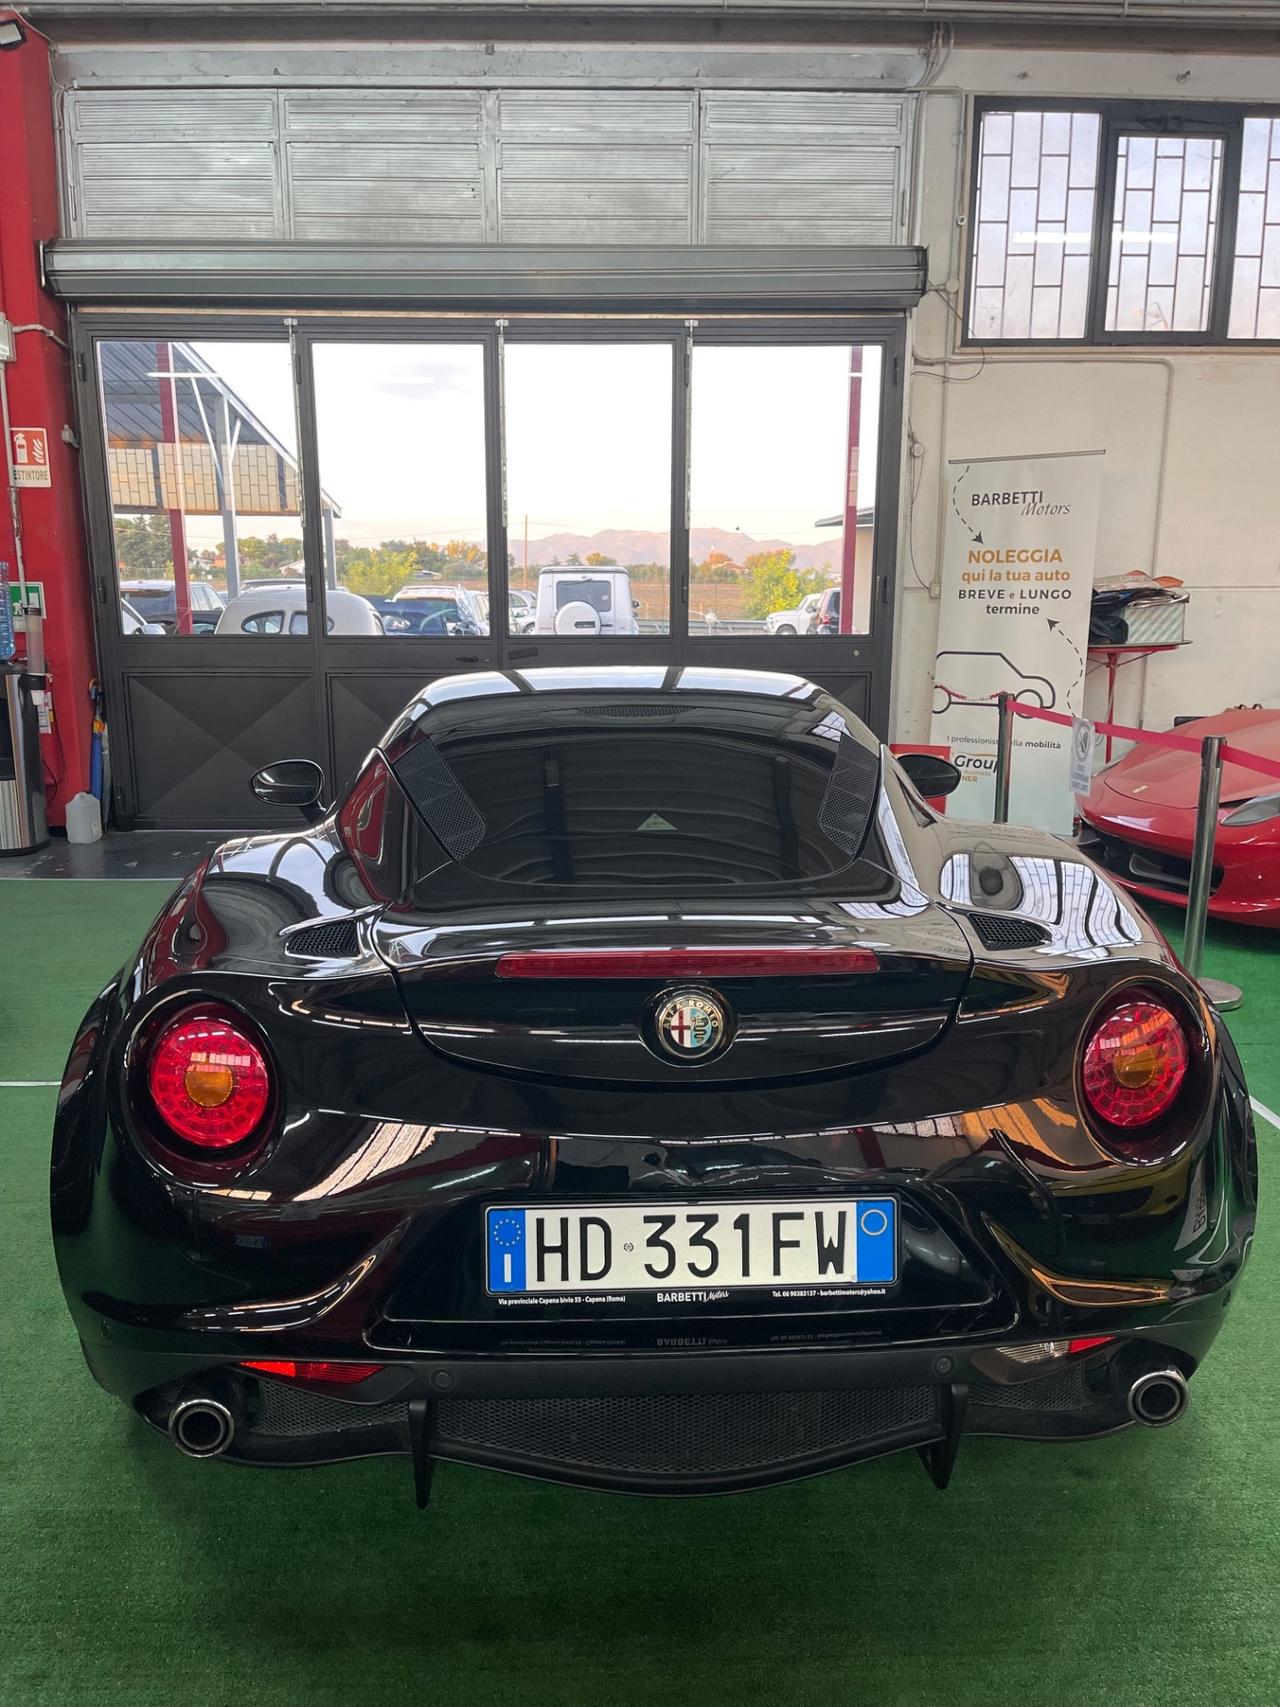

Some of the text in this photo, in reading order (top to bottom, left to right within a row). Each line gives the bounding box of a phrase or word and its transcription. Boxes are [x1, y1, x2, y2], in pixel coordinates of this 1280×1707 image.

[13, 469, 49, 480] ESTINTORE
[971, 490, 1043, 506] BARBETTI
[1020, 502, 1071, 516] Motors
[968, 549, 1063, 564] NOLEGGIA
[961, 569, 1070, 584] qui la tua auto
[958, 589, 1072, 600] BREVE e LUNGO
[986, 603, 1040, 615] termine
[1024, 740, 1061, 750] mobilità
[663, 1000, 718, 1029] ALFA ROMEO
[536, 1216, 612, 1282] HD
[656, 1291, 706, 1303] BARBETTI
